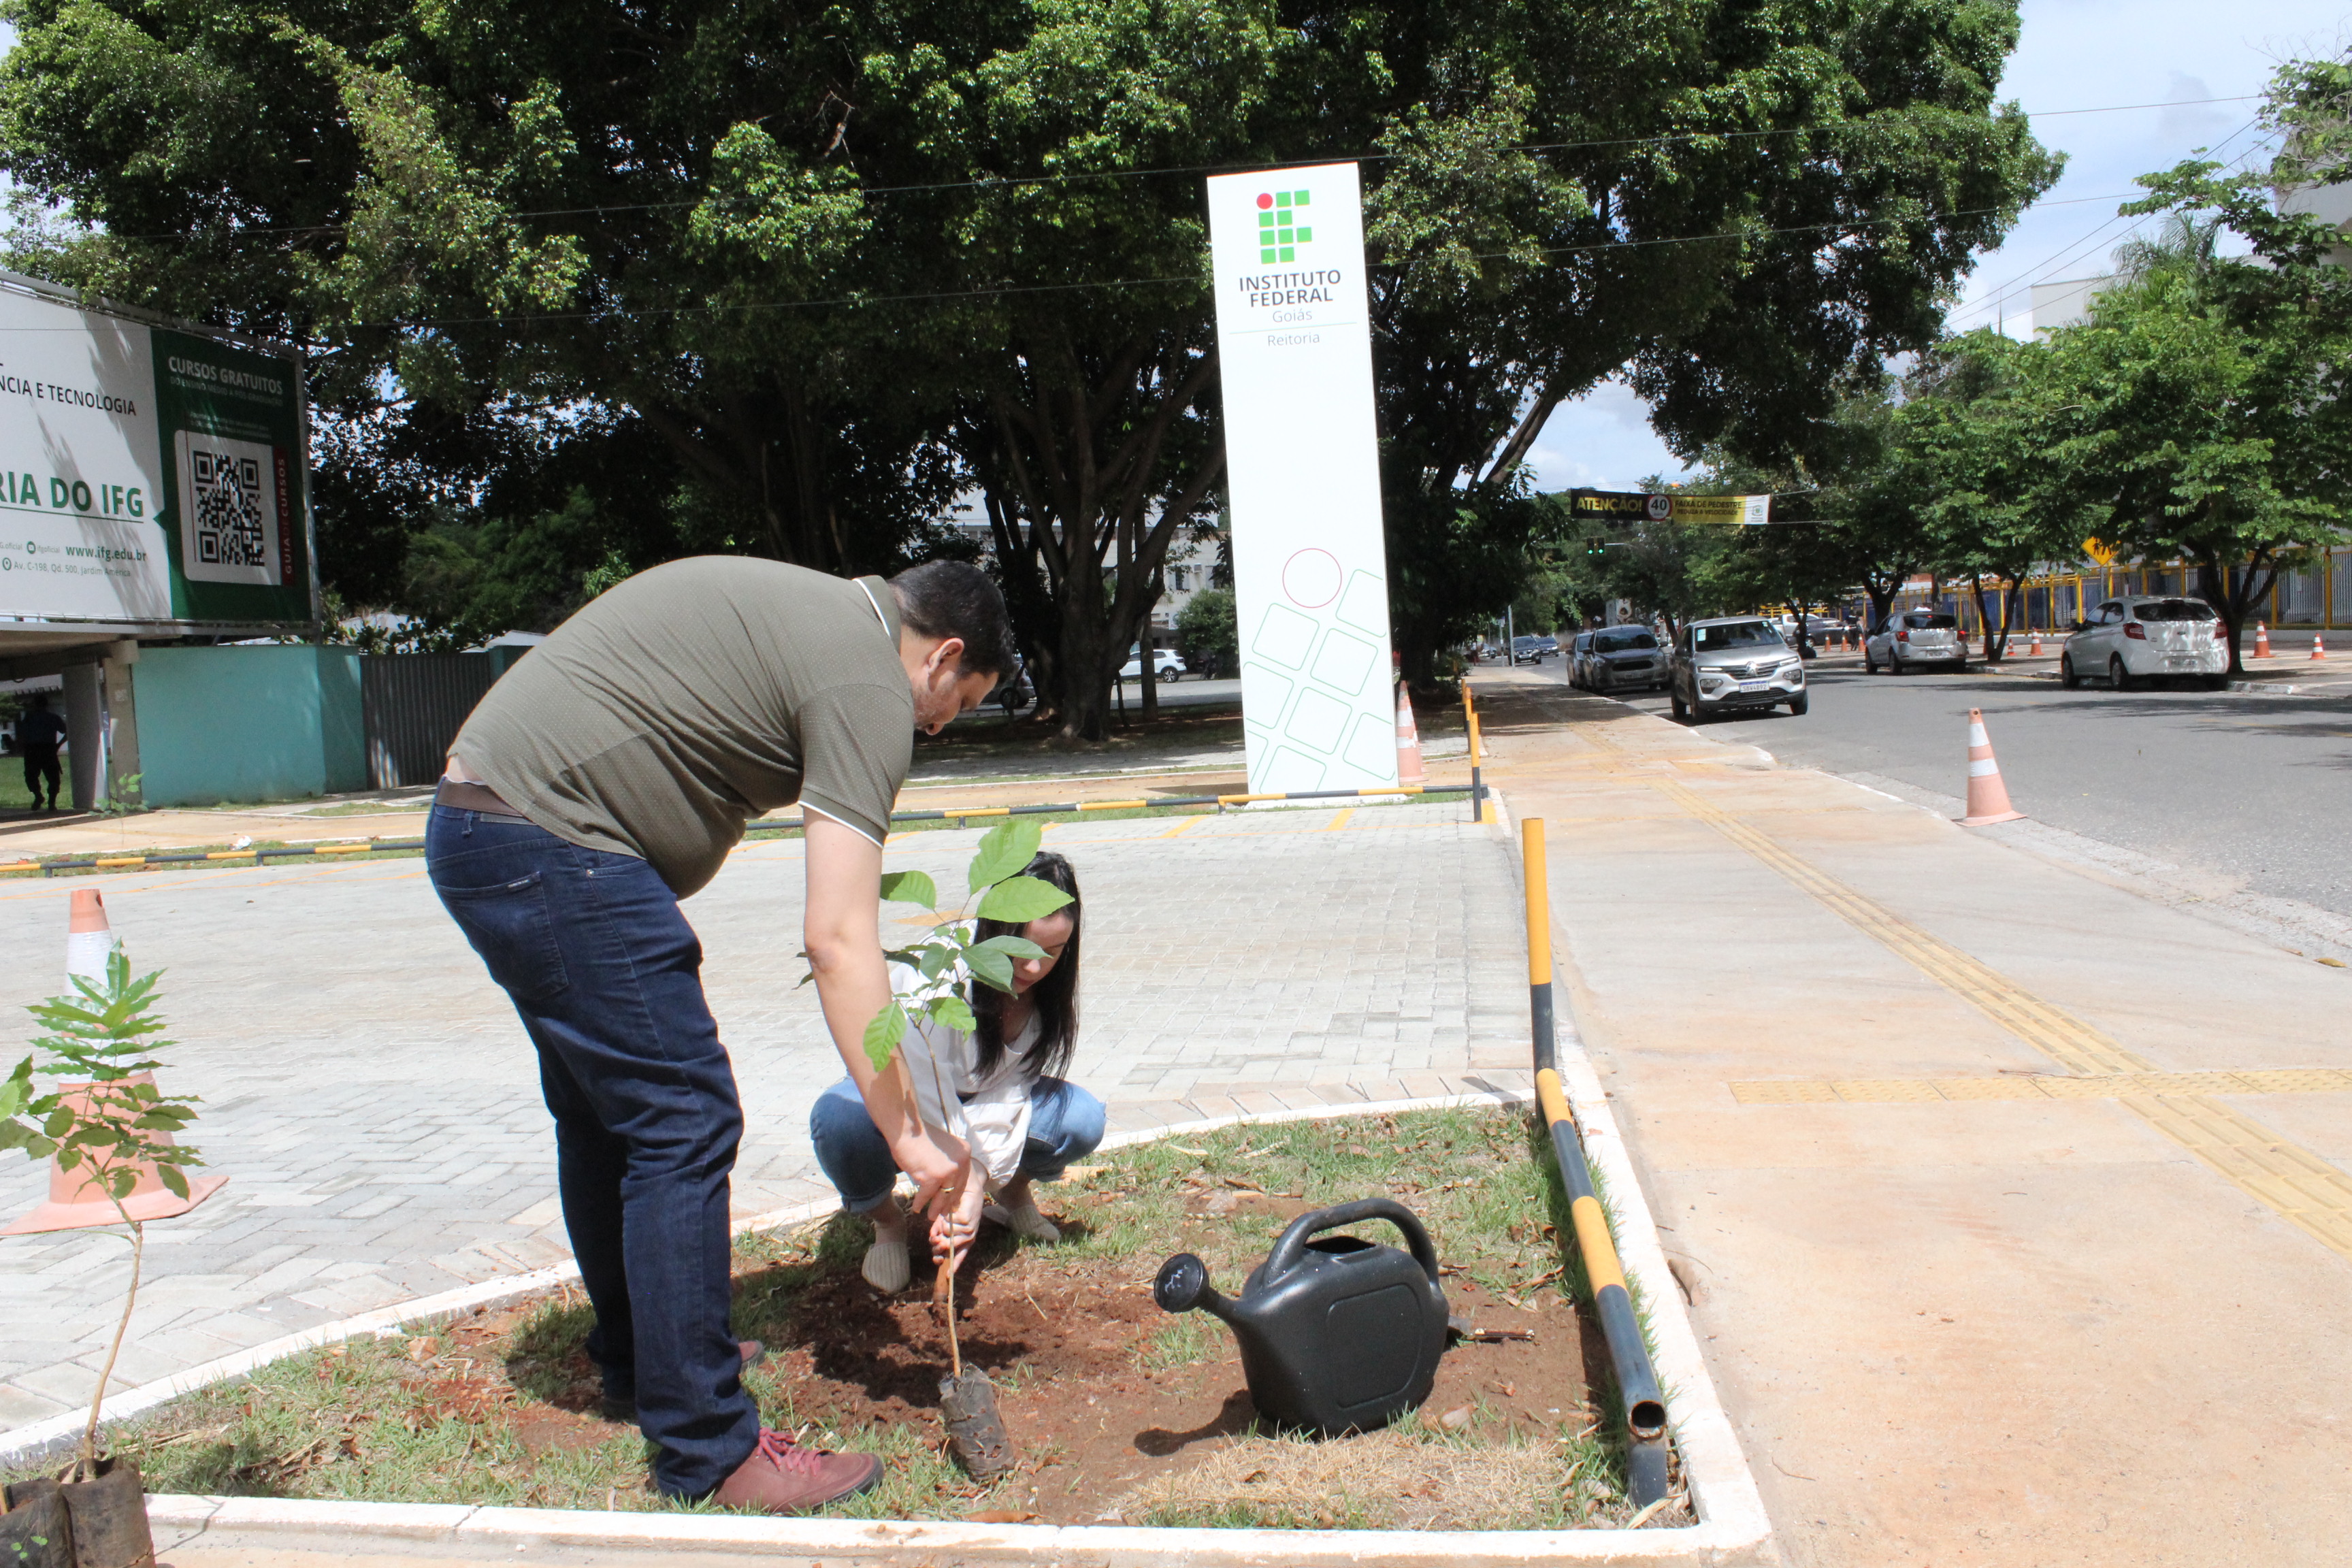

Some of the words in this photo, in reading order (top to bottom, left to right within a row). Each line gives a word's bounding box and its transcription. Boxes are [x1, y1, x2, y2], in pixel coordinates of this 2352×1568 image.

[1239, 270, 1341, 292] INSTITUTO
[1250, 287, 1333, 308] FEDERAL
[1272, 308, 1313, 323] Goiás
[1268, 332, 1320, 347] Reitoria
[168, 356, 218, 381] CURSOS
[220, 368, 284, 395] GRATUITOS
[36, 382, 44, 399] E
[48, 384, 137, 416] TECNOLOGIA
[50, 476, 92, 512] DO
[101, 483, 144, 517] IFG
[1576, 495, 1643, 514] ATENÇÃO!
[1651, 499, 1667, 511] 40
[1708, 501, 1742, 509] PEDESTRE
[65, 546, 147, 562] www.ifg.edu.br
[14, 561, 25, 570] Av.
[81, 566, 102, 576] Jardim
